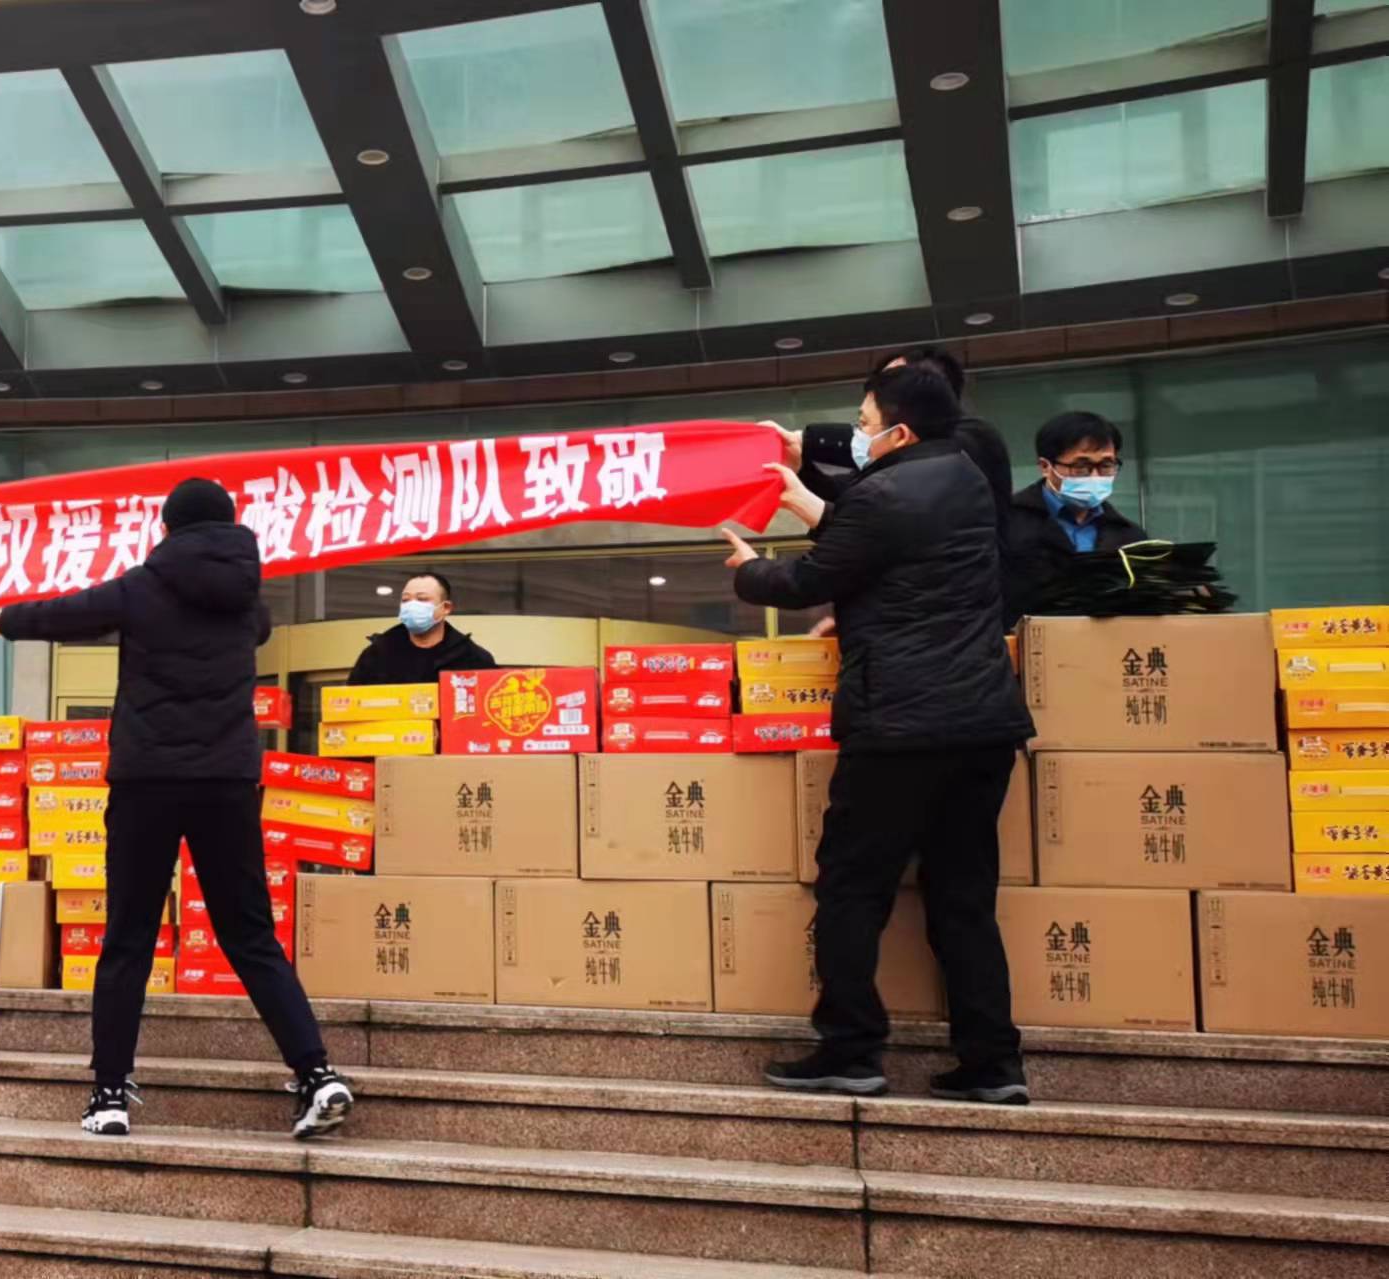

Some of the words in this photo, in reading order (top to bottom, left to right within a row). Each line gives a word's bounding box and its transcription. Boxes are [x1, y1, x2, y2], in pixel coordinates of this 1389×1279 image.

[1122, 646, 1168, 676] 金典
[1122, 678, 1168, 687] SATINE
[1126, 695, 1167, 725] 纯牛奶
[456, 782, 494, 809] 金典
[665, 780, 705, 809] 金典
[1139, 784, 1186, 814] 金典
[666, 810, 704, 818] SATINE
[1141, 815, 1186, 825] SATINE
[458, 826, 492, 853] 纯牛奶
[668, 826, 704, 854] 纯牛奶
[1144, 833, 1185, 864] 纯牛奶
[374, 903, 411, 930] 金典
[582, 911, 622, 939] 金典
[583, 940, 620, 949] SATINE
[1045, 921, 1090, 952] 金典
[1306, 927, 1356, 958] 金典
[376, 947, 409, 975] 纯牛奶
[585, 957, 620, 985] 纯牛奶
[1046, 952, 1090, 963] SATINE
[1308, 958, 1355, 969] SATINE
[1050, 971, 1090, 1002] 纯牛奶
[1312, 976, 1355, 1008] 纯牛奶
